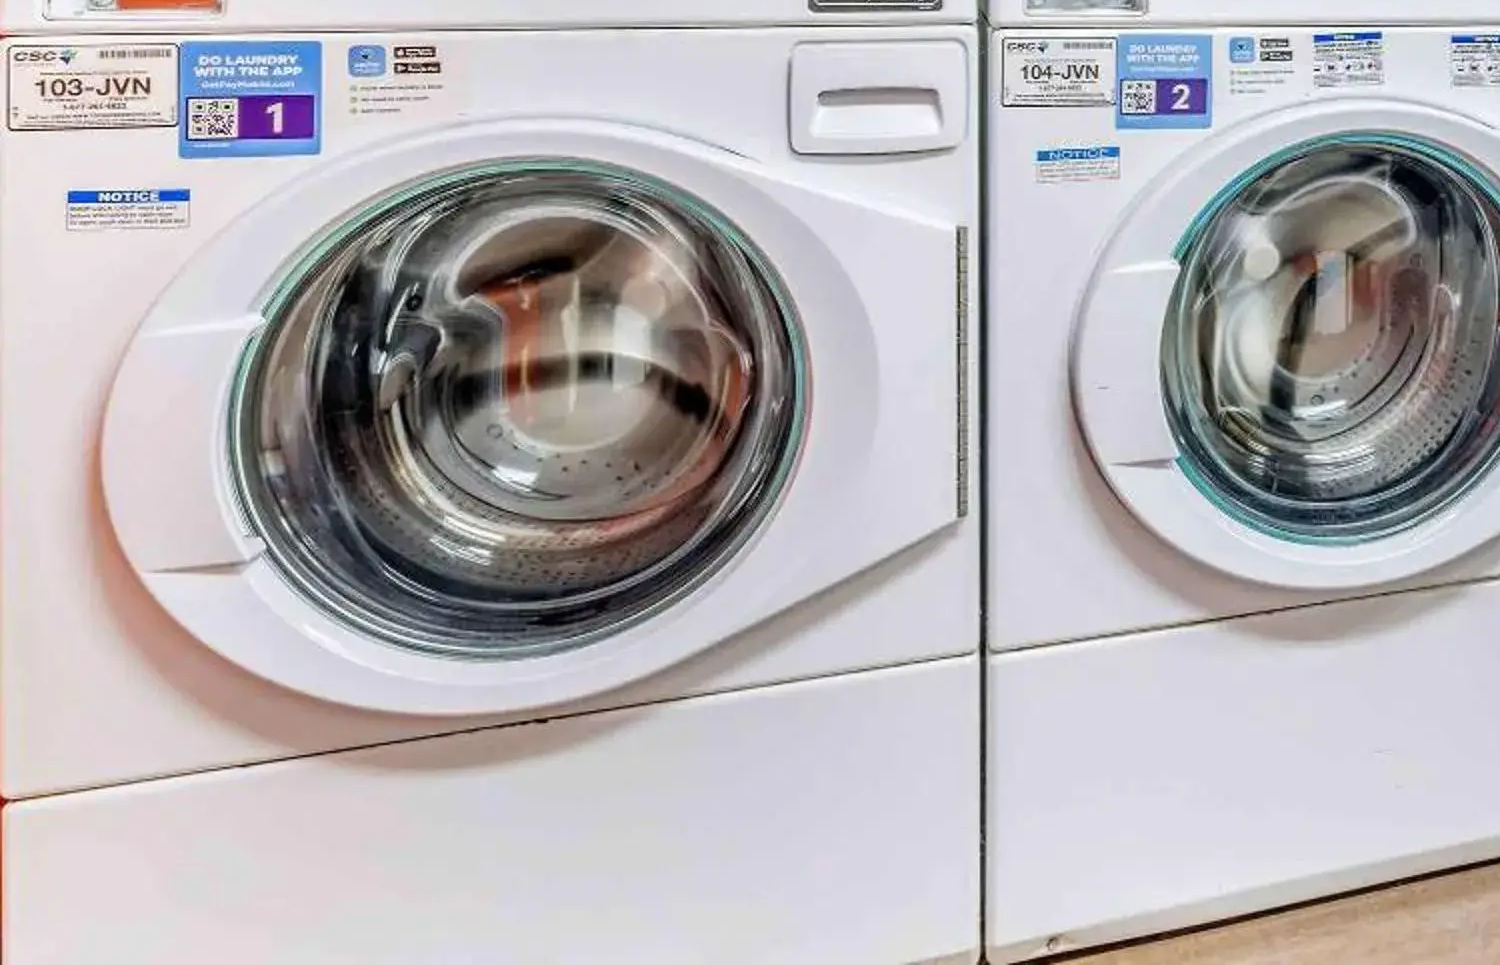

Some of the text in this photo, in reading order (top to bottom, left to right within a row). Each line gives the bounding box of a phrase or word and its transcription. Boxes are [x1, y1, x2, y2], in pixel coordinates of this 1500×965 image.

[14, 50, 57, 62] CSC
[198, 54, 300, 66] DO LAUNDRY
[194, 66, 304, 77] WITH THE APP
[1020, 64, 1100, 81] 104-JVN
[34, 76, 152, 97] 103-JVN
[1170, 83, 1191, 110] 2
[265, 102, 283, 134] 1
[97, 191, 160, 203] NOTICE
